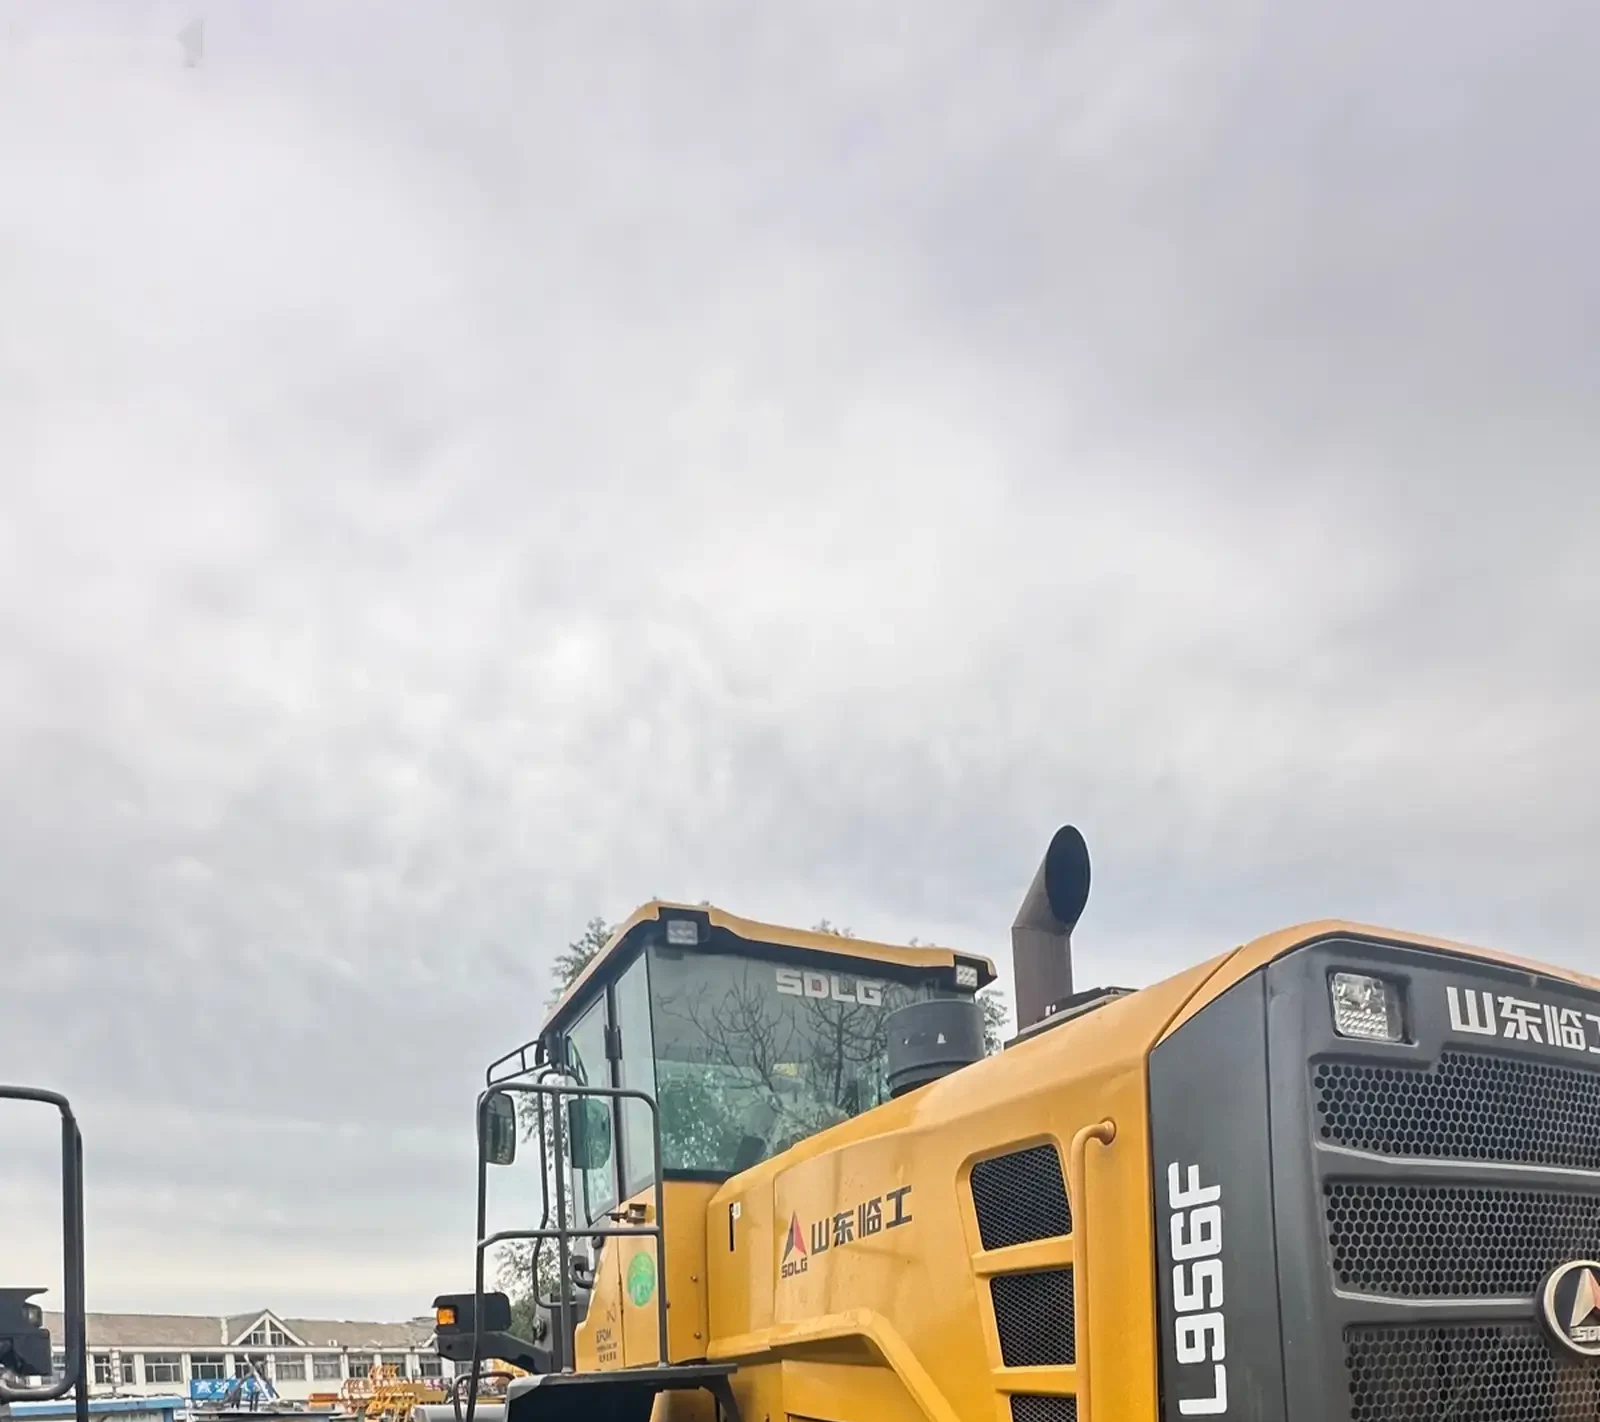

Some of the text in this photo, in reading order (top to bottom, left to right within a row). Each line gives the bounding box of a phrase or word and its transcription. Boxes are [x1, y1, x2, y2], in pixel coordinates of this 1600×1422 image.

[776, 967, 882, 1006] SDLG
[811, 1185, 912, 1256] 山东临工
[781, 1257, 807, 1279] SDLG
[1168, 1162, 1228, 1415] L956F
[1571, 1326, 1600, 1341] SD
